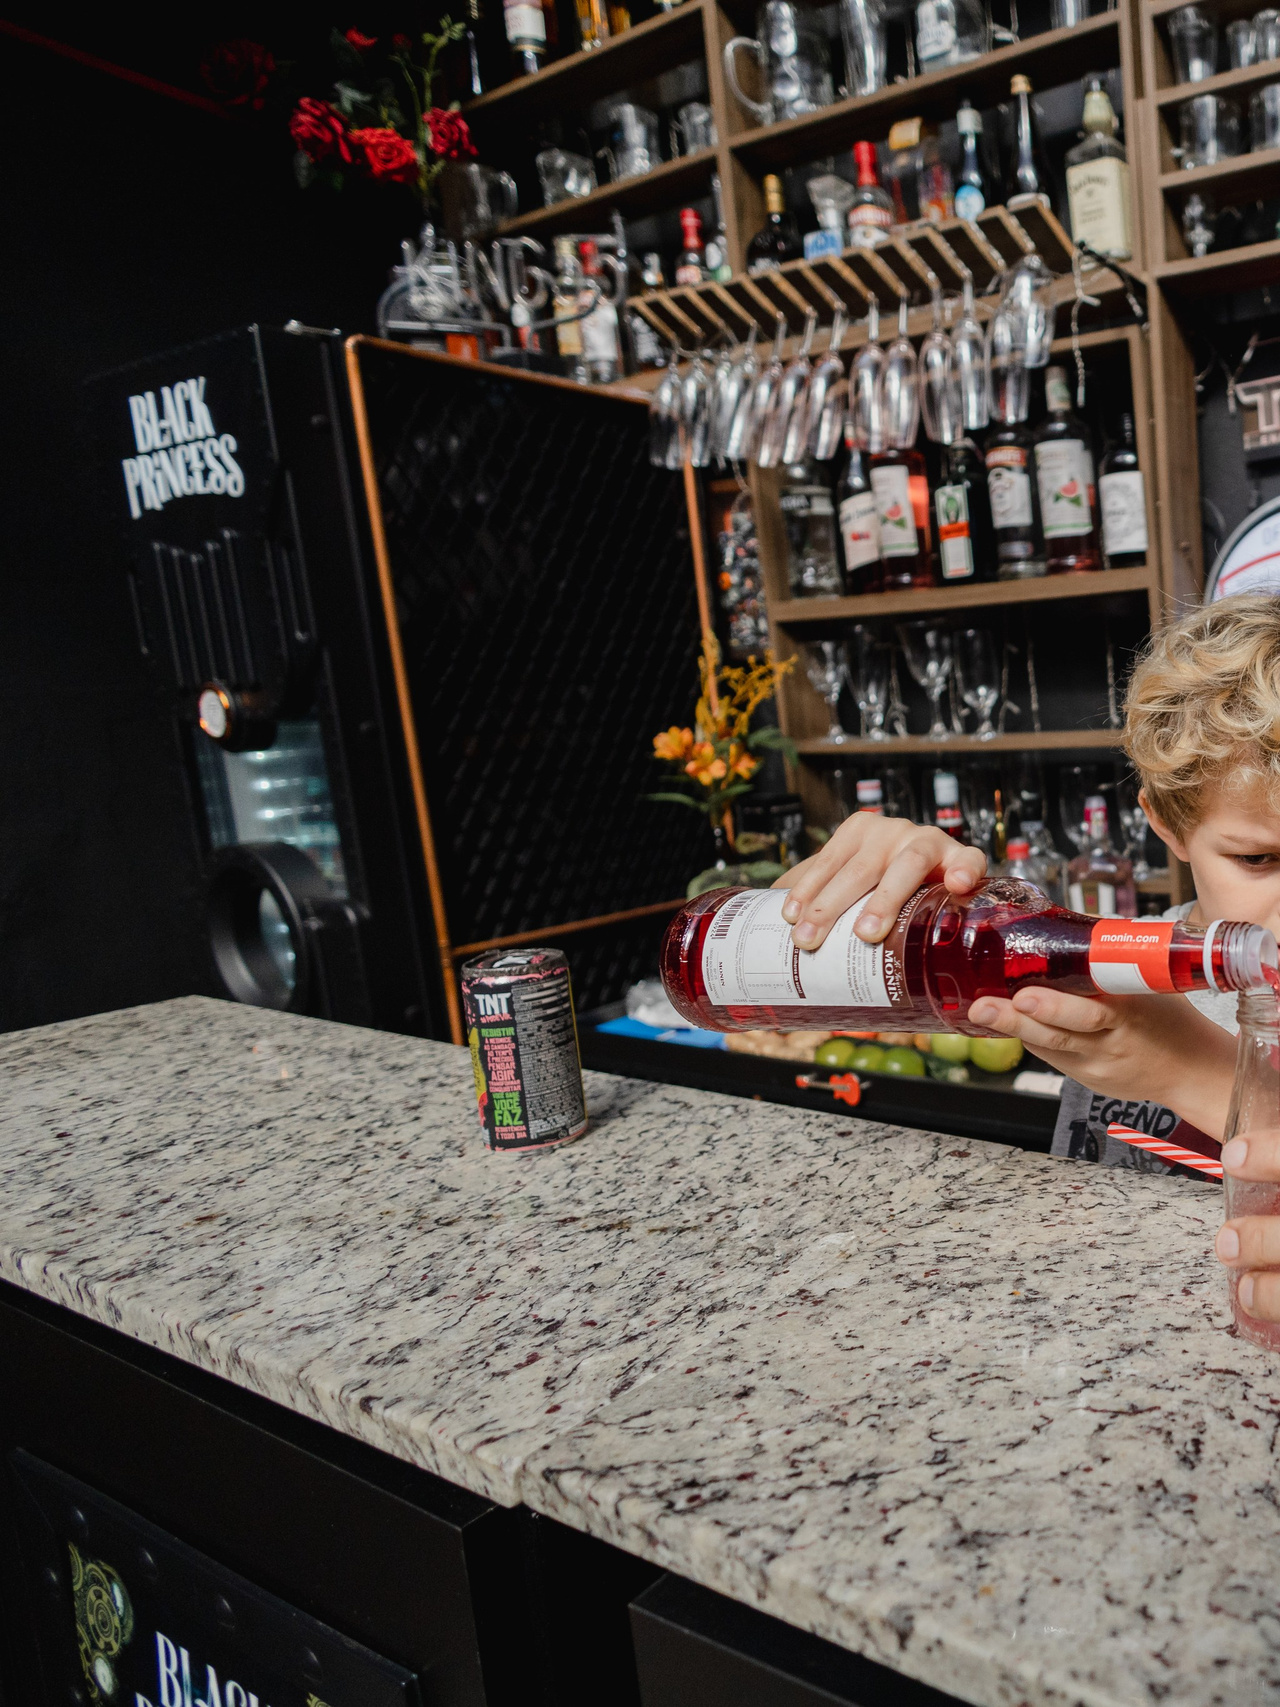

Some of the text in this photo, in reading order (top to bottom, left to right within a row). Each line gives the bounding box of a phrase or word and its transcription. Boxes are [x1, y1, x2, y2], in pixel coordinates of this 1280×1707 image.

[128, 376, 216, 453] BLACK
[1100, 933, 1160, 943] monin.com
[885, 950, 900, 1001] MONIN
[474, 992, 512, 1016] TNT
[480, 1026, 516, 1038] RESISTIR
[487, 1062, 516, 1071] PENSAR
[491, 1070, 515, 1082] AGIR
[494, 1108, 524, 1126] FAZ
[1089, 1094, 1176, 1138] EGEND
[154, 1630, 272, 1707] BLA
